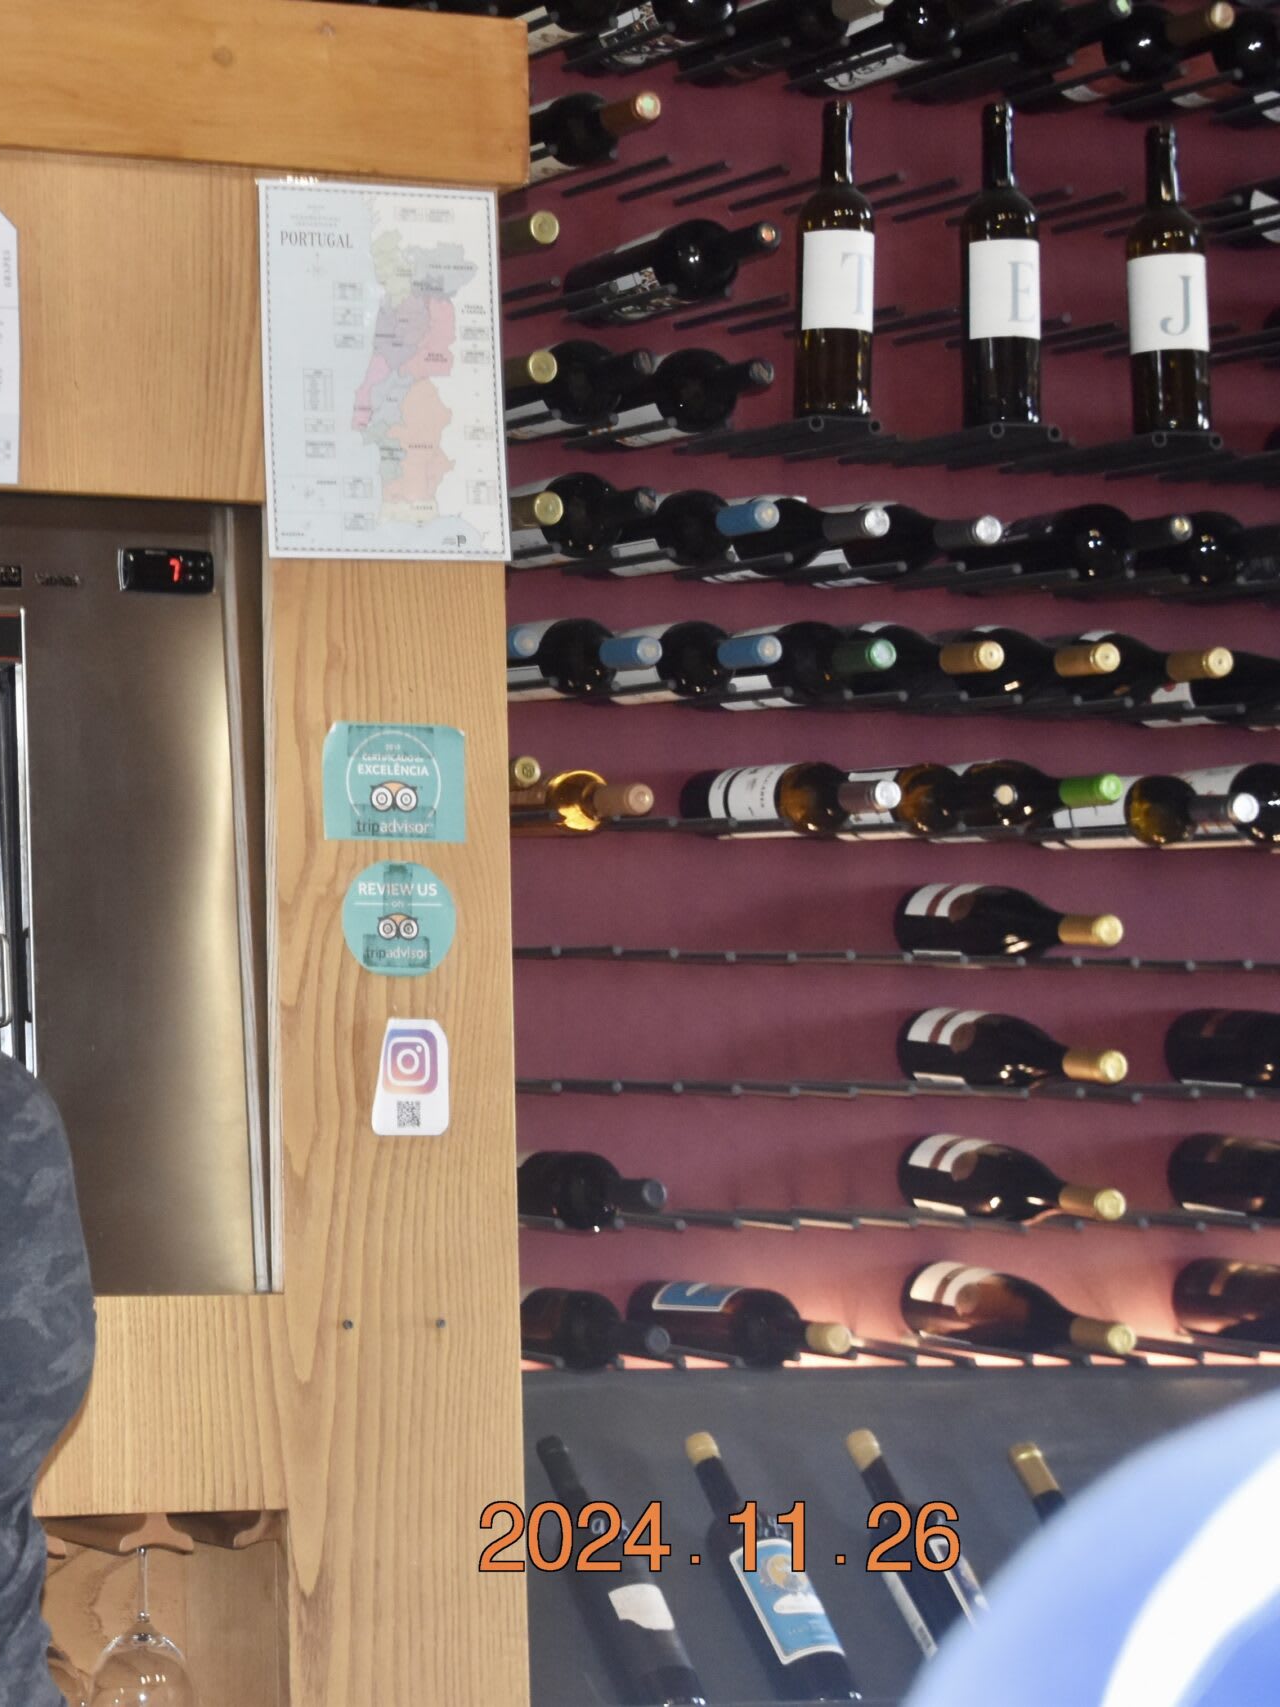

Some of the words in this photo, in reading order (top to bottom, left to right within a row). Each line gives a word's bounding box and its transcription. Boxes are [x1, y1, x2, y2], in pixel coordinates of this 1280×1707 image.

[280, 230, 354, 249] PORTUGAL
[841, 251, 872, 316] T
[1008, 260, 1036, 323] E
[1160, 275, 1192, 337] J
[170, 557, 181, 582] 7
[357, 761, 429, 777] EXCELÊNCIA
[356, 818, 429, 837] tripadvisor
[358, 881, 415, 897] REVIEW
[417, 882, 439, 897] US
[365, 945, 429, 961] tripadvisor
